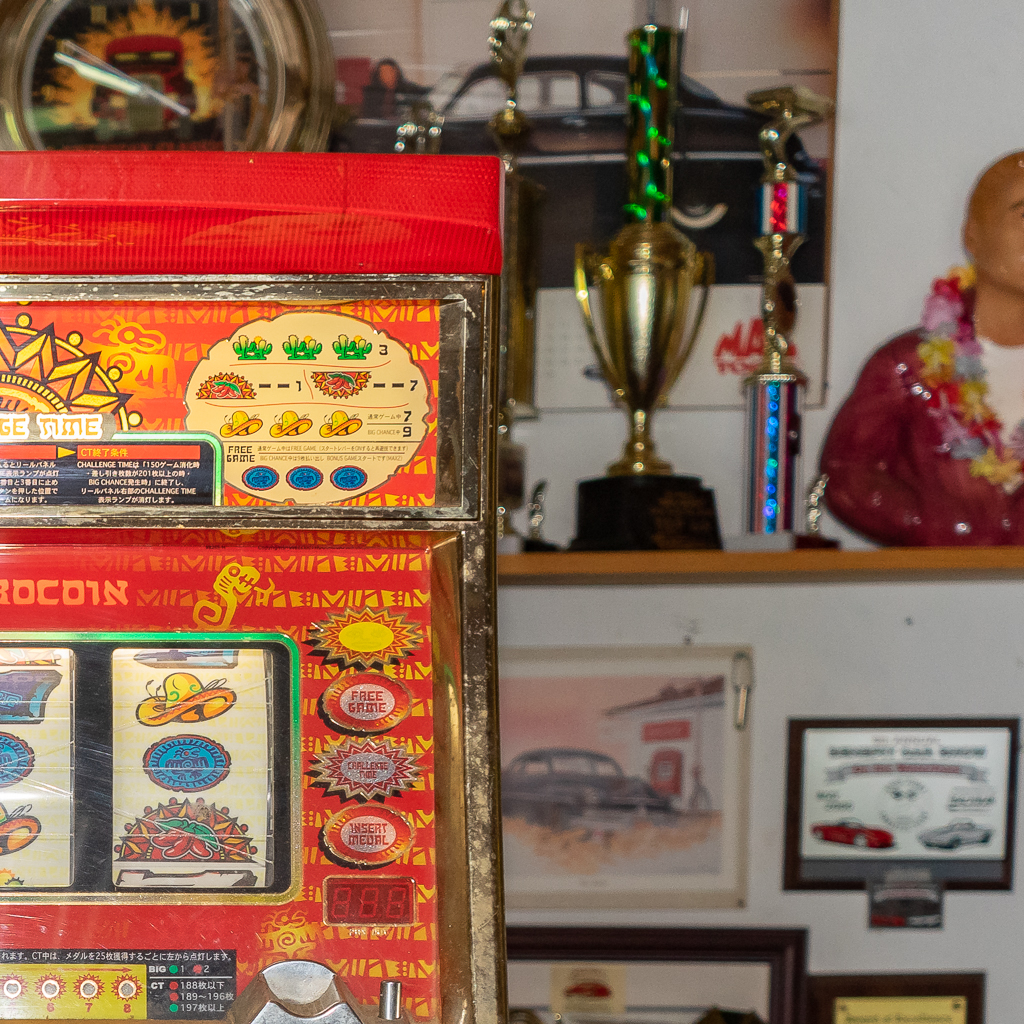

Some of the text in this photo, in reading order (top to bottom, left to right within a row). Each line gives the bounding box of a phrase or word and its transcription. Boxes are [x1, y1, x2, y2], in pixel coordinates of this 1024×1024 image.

[378, 344, 388, 356] 3
[403, 410, 412, 422] 7
[38, 415, 101, 438] TIME
[402, 426, 412, 438] 9
[80, 448, 128, 457] CT終了条件
[228, 446, 253, 454] FREE
[226, 454, 256, 462] GAME
[352, 690, 384, 701] FREE
[348, 702, 387, 713] GAME
[348, 762, 388, 770] CHALLENGE
[350, 822, 388, 834] INSERT
[348, 834, 389, 846] MEDAL
[204, 965, 210, 973] 2
[151, 982, 165, 990] CT
[46, 1002, 55, 1012] 6
[85, 1002, 93, 1012] 7
[123, 1004, 132, 1014] 8
